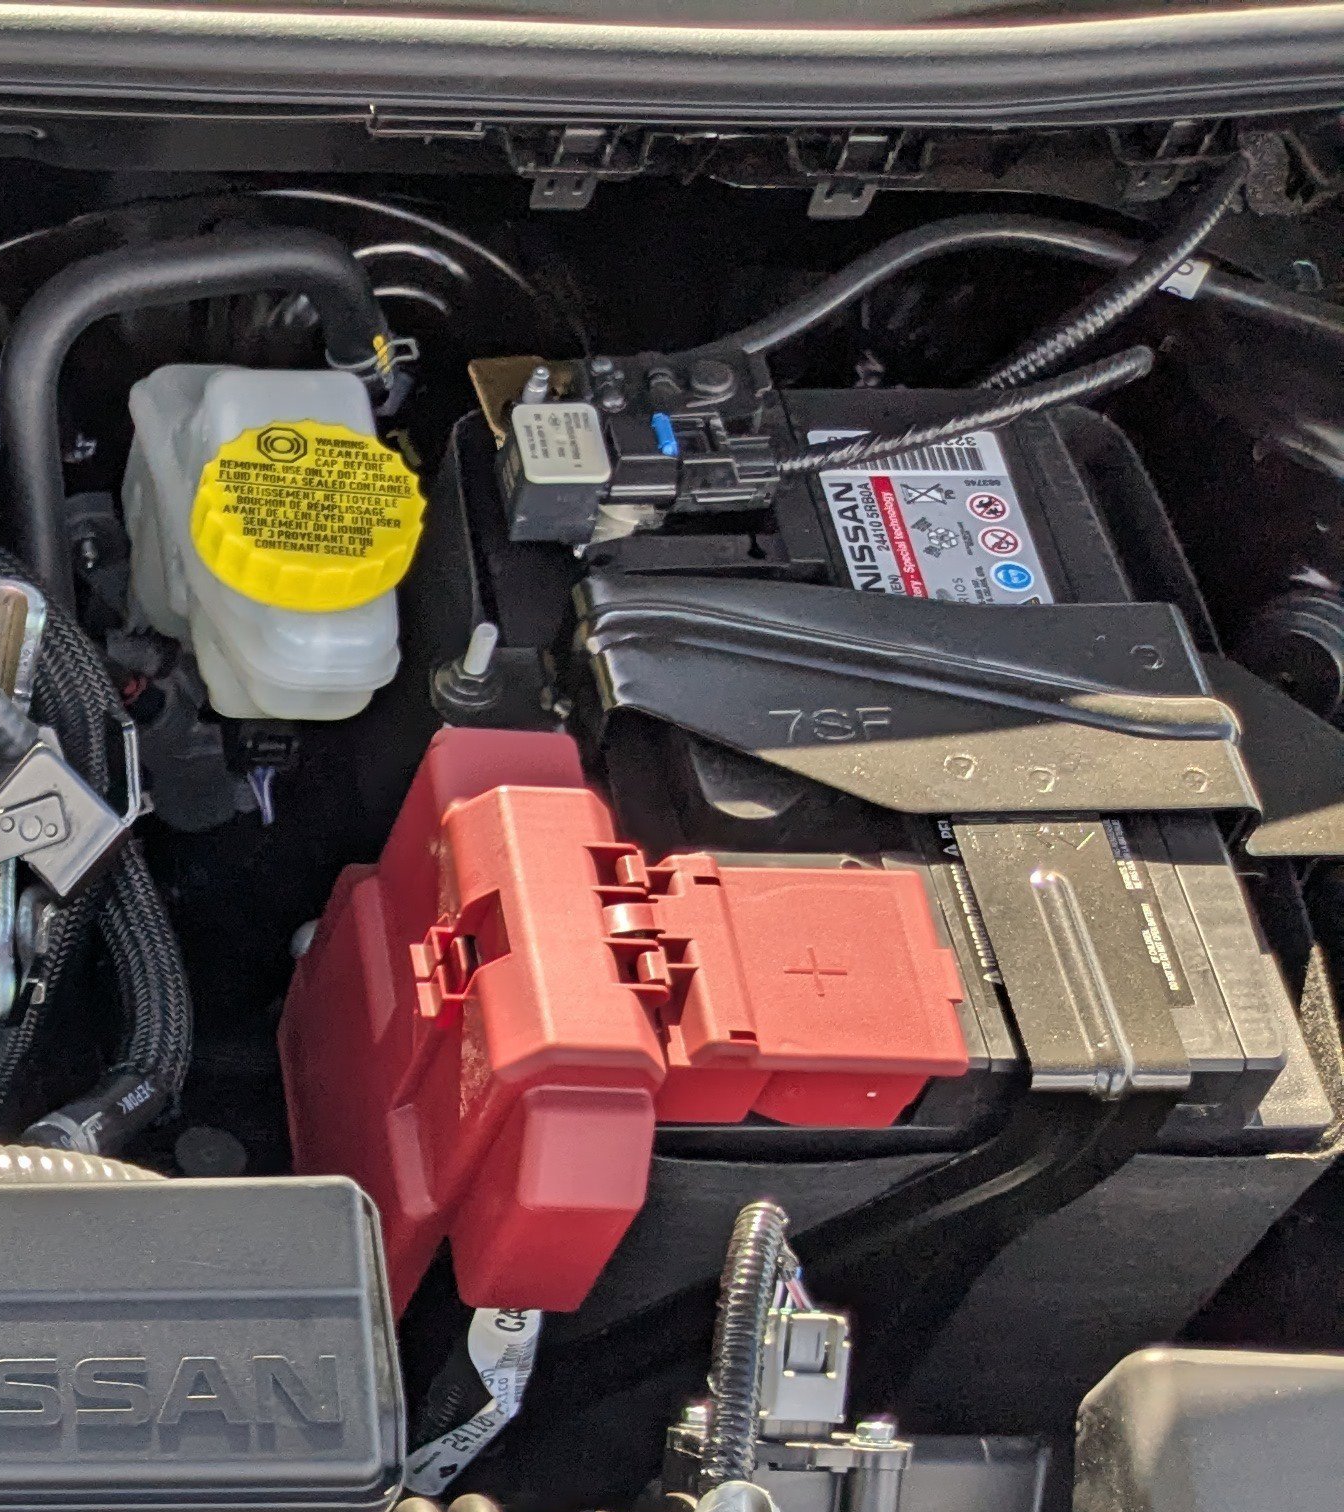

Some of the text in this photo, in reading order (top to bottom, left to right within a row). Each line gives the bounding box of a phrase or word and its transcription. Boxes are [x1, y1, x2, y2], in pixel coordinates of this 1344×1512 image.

[315, 448, 393, 462] CLEAN FILLER
[282, 465, 302, 476] USE
[305, 467, 333, 479] ONLY
[337, 469, 358, 481] DOT
[362, 471, 369, 481] 3
[372, 473, 410, 485] BRAKE
[315, 458, 384, 473] CAP BEFORE
[219, 469, 251, 481] FLUID
[255, 472, 286, 485] FROM
[290, 475, 298, 486] A
[302, 478, 346, 490] SEALED
[236, 495, 286, 508] BOUCHON
[289, 500, 302, 510] DE
[323, 493, 381, 505] NETTOYER
[385, 497, 398, 508] LE
[222, 504, 261, 517] AVANT
[266, 507, 280, 518] DE
[351, 516, 401, 529] UTILISER
[881, 491, 904, 539] technology
[243, 526, 264, 537] DOT
[267, 529, 275, 539] 3
[277, 530, 344, 545] PROVENANT
[313, 522, 327, 533] DU
[331, 525, 372, 537] LIQUIDE
[828, 482, 886, 593] NISSAN
[255, 538, 320, 553] CONTENANT
[896, 537, 916, 574] Special
[768, 707, 892, 742] 7SF
